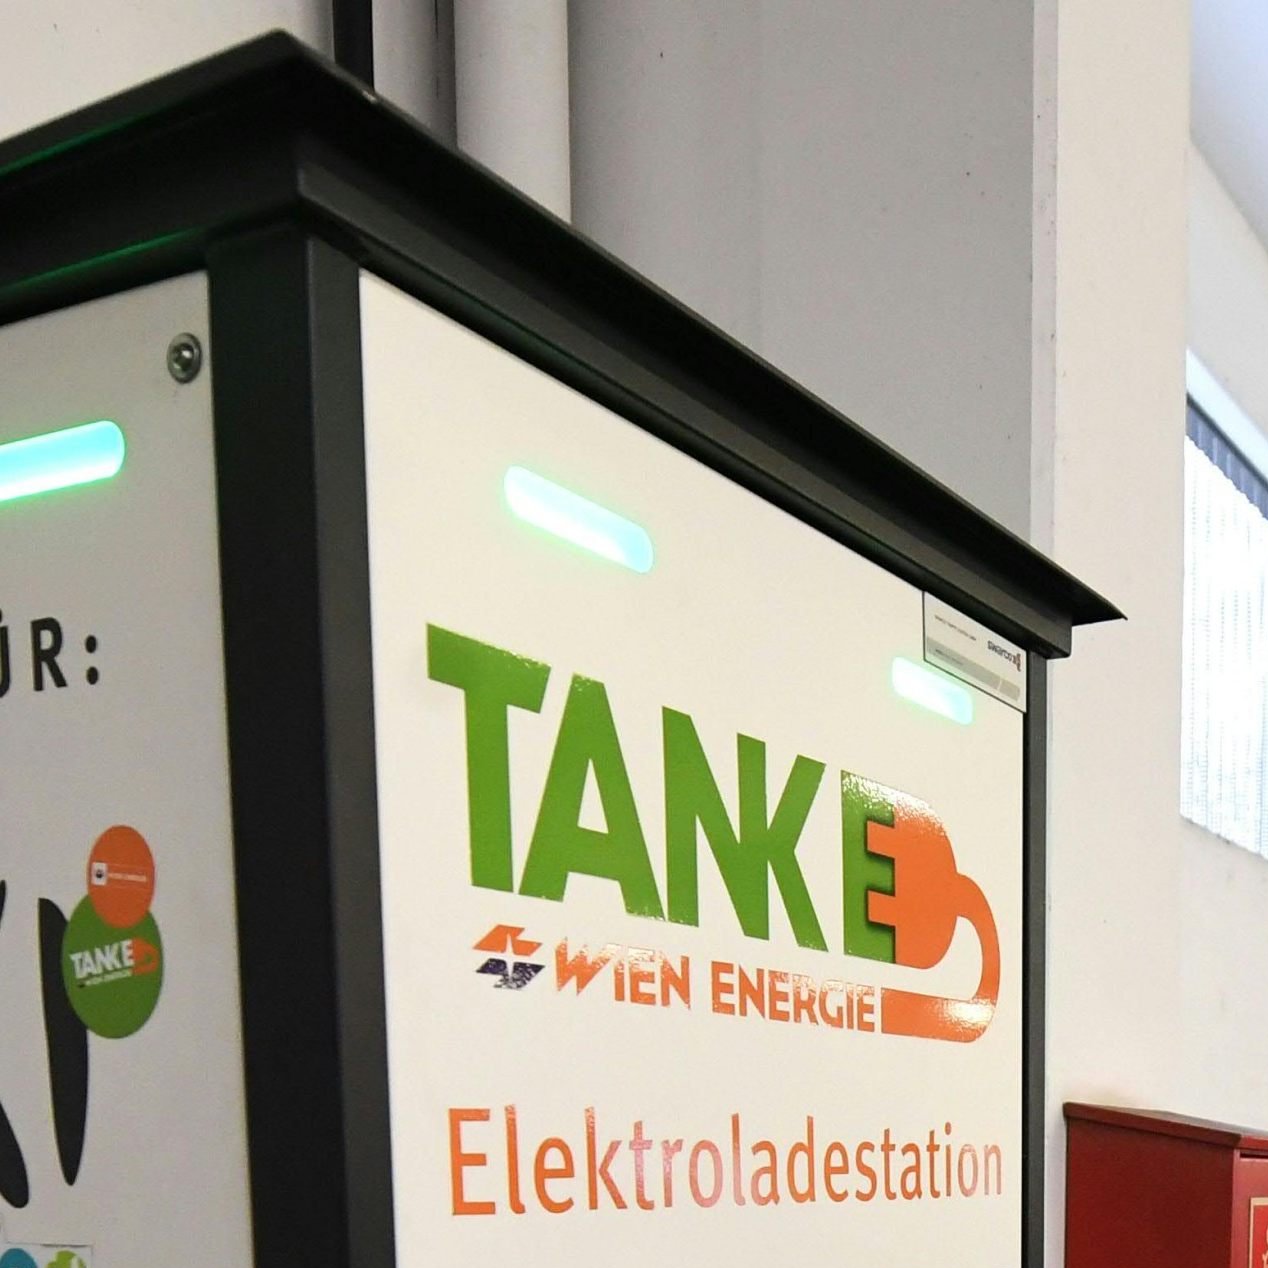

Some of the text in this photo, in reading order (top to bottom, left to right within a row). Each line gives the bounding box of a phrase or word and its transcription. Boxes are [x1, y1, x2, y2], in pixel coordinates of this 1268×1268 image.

[426, 622, 897, 965] TANKE
[69, 938, 135, 979] TANKE
[554, 937, 875, 1033] WIEN ENERGIE
[448, 1104, 1002, 1217] Elektroladestation
